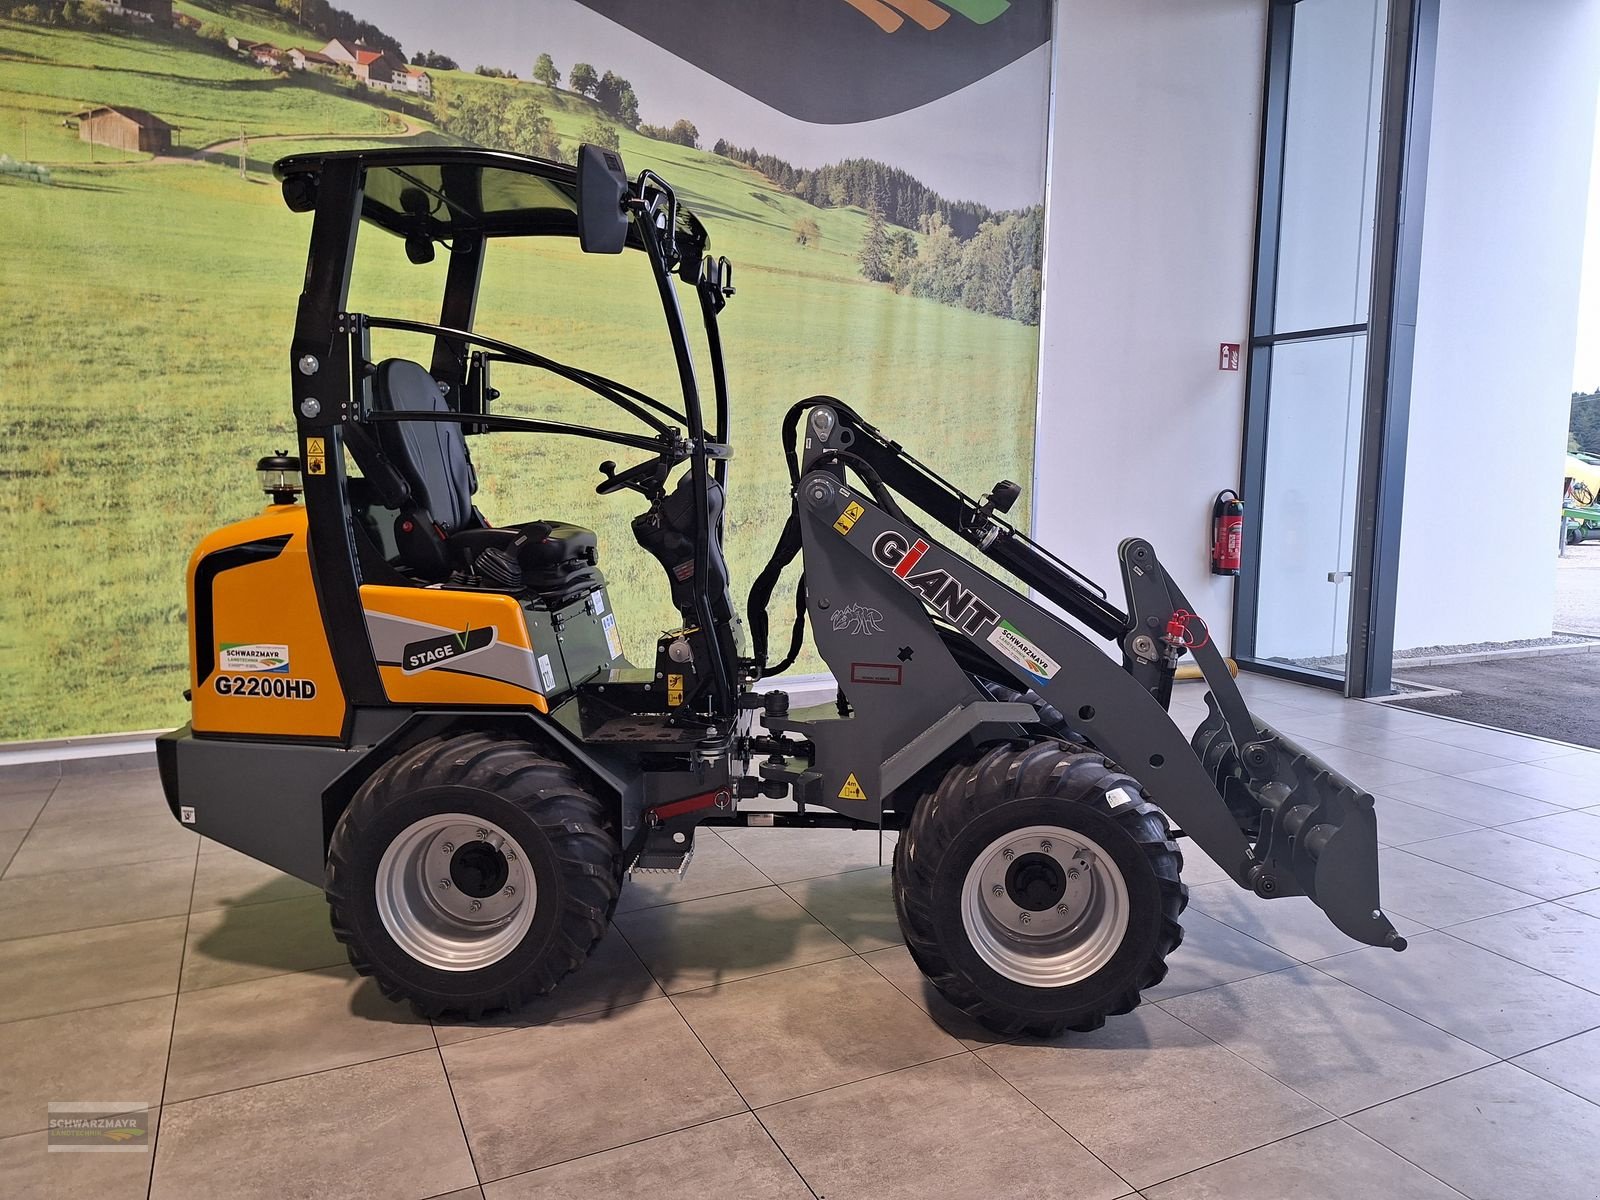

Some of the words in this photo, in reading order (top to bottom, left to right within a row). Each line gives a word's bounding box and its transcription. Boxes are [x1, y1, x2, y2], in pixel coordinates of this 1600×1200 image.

[226, 650, 279, 658] SCHWARZMAYR
[410, 644, 454, 667] STAGE
[1002, 629, 1049, 670] SCHWARZMAYR
[214, 675, 317, 699] G2200HD
